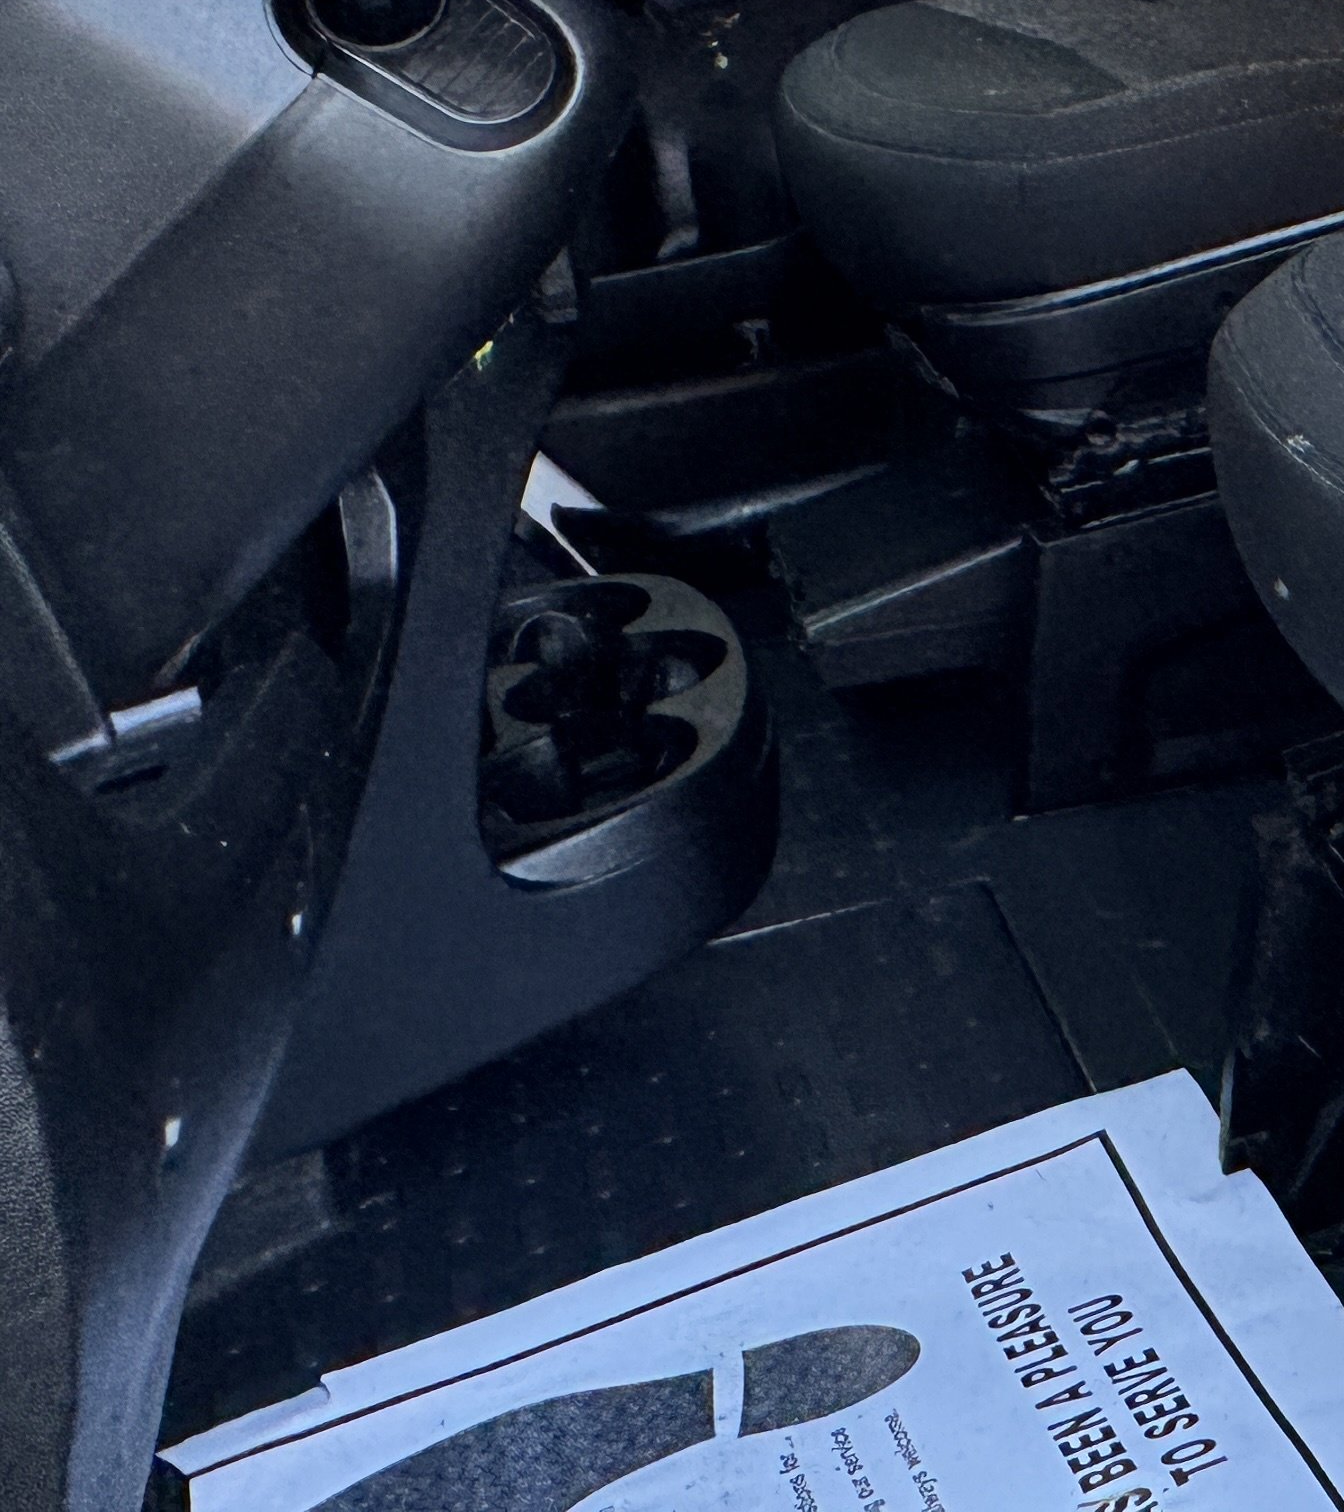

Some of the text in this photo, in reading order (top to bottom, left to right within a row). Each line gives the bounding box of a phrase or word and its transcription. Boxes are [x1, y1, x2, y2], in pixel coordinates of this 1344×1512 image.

[961, 1251, 1077, 1388] PLEASURE
[1034, 1380, 1093, 1410] A
[1067, 1294, 1229, 1487] TO SERVE YOU
[1047, 1406, 1138, 1494] BEEN
